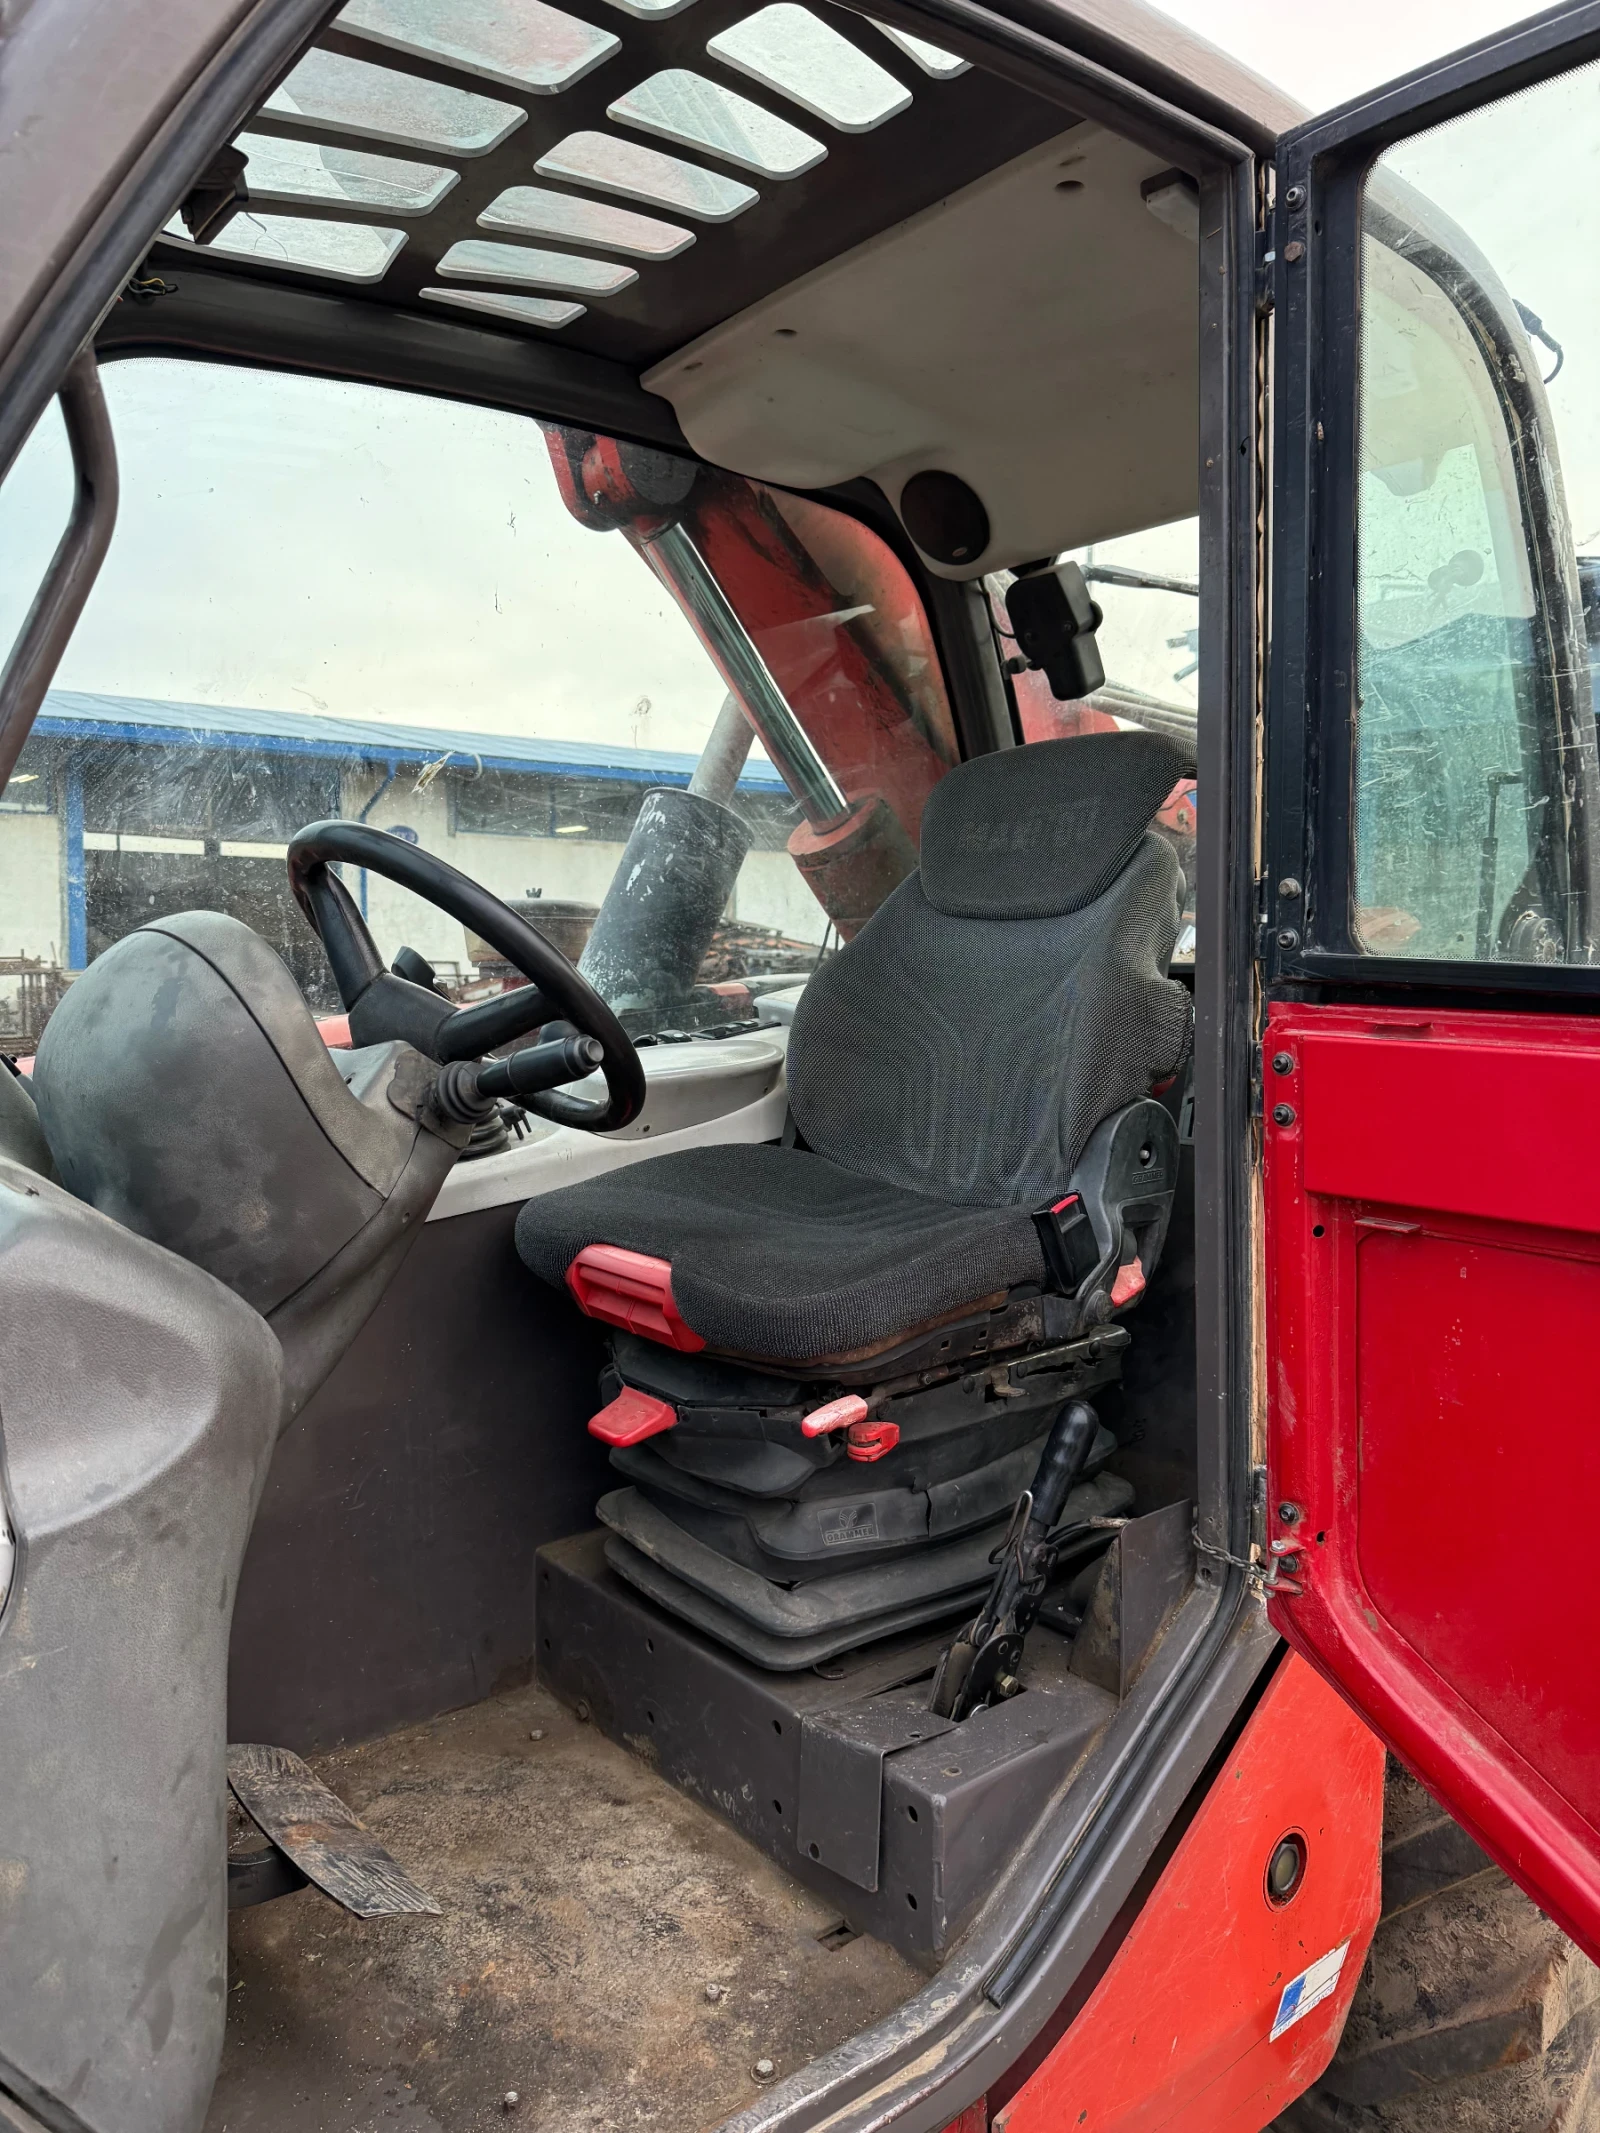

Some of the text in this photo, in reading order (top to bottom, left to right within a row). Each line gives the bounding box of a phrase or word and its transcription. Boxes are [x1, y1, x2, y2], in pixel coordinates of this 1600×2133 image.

[826, 1526, 874, 1543] GRAMMER
[1272, 2020, 1292, 2039] MADE
[1307, 1986, 1334, 2010] FRANCE
